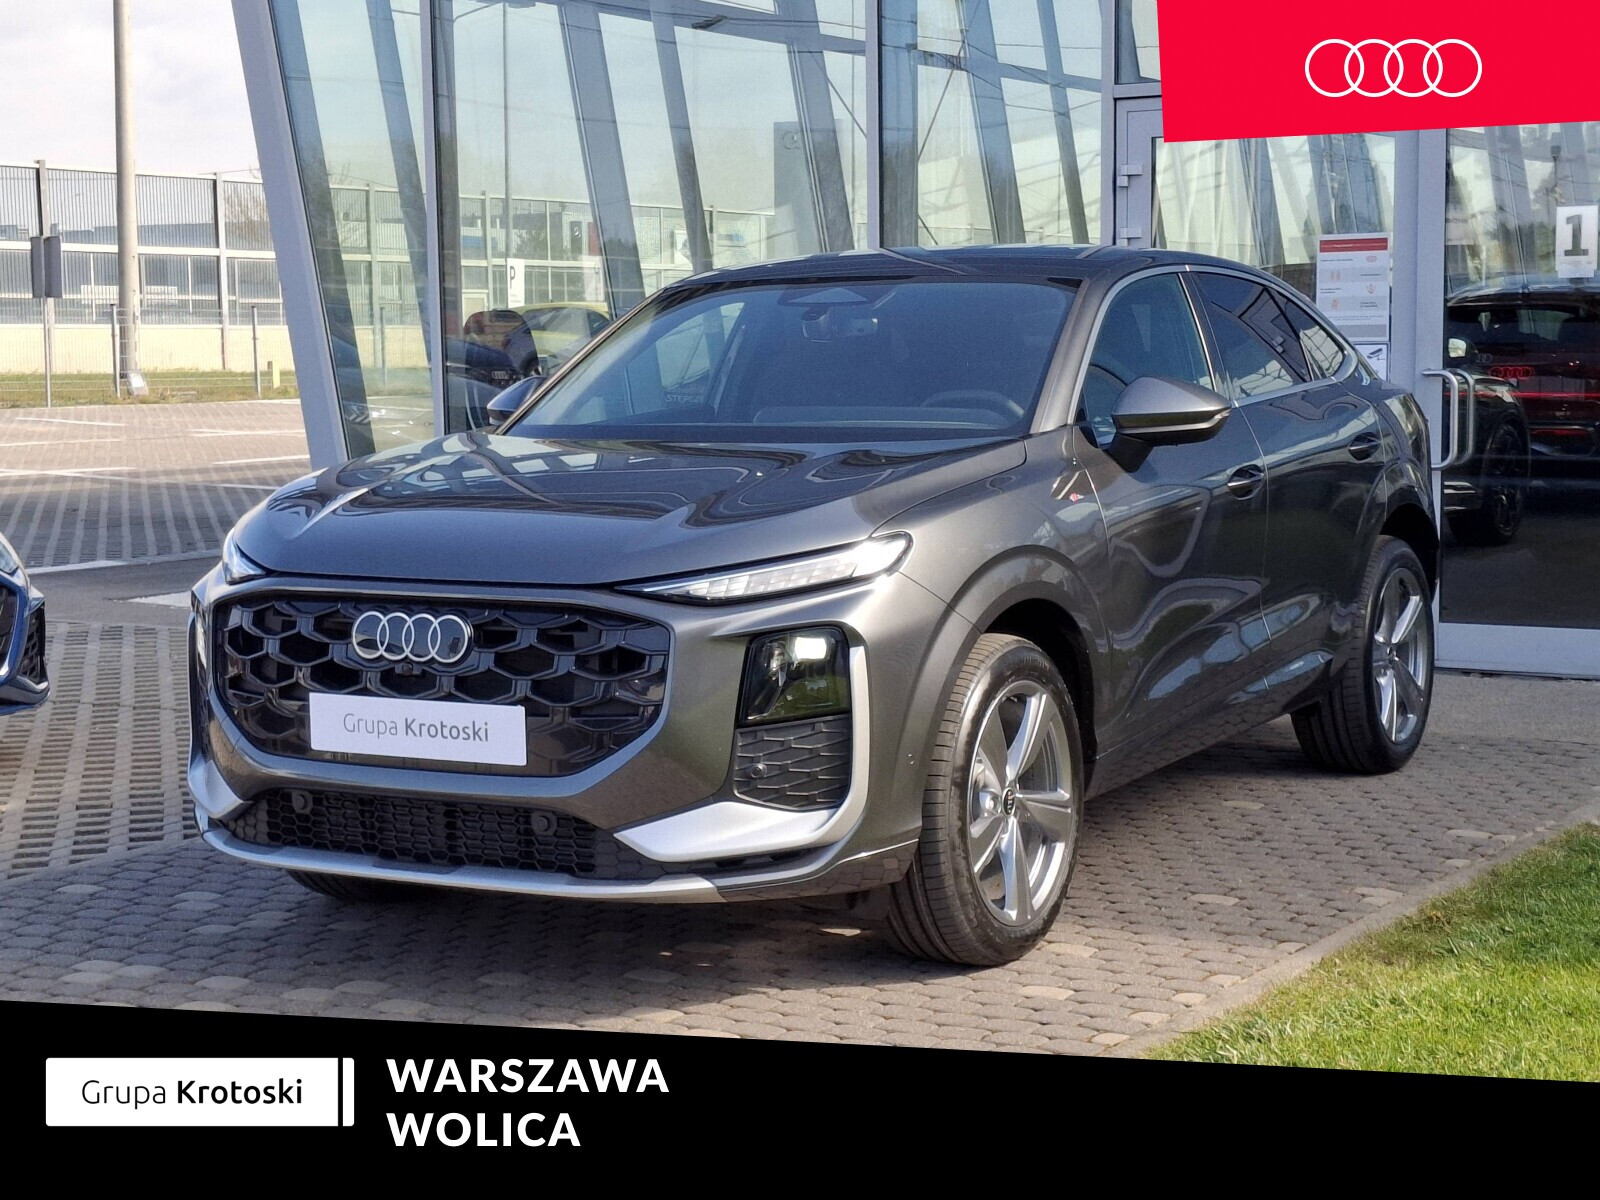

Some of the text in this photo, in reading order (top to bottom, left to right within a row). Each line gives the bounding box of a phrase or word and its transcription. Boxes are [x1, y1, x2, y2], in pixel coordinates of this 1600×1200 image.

[1563, 214, 1589, 257] 1
[509, 265, 516, 290] P
[343, 713, 489, 742] Grupa Krotoski
